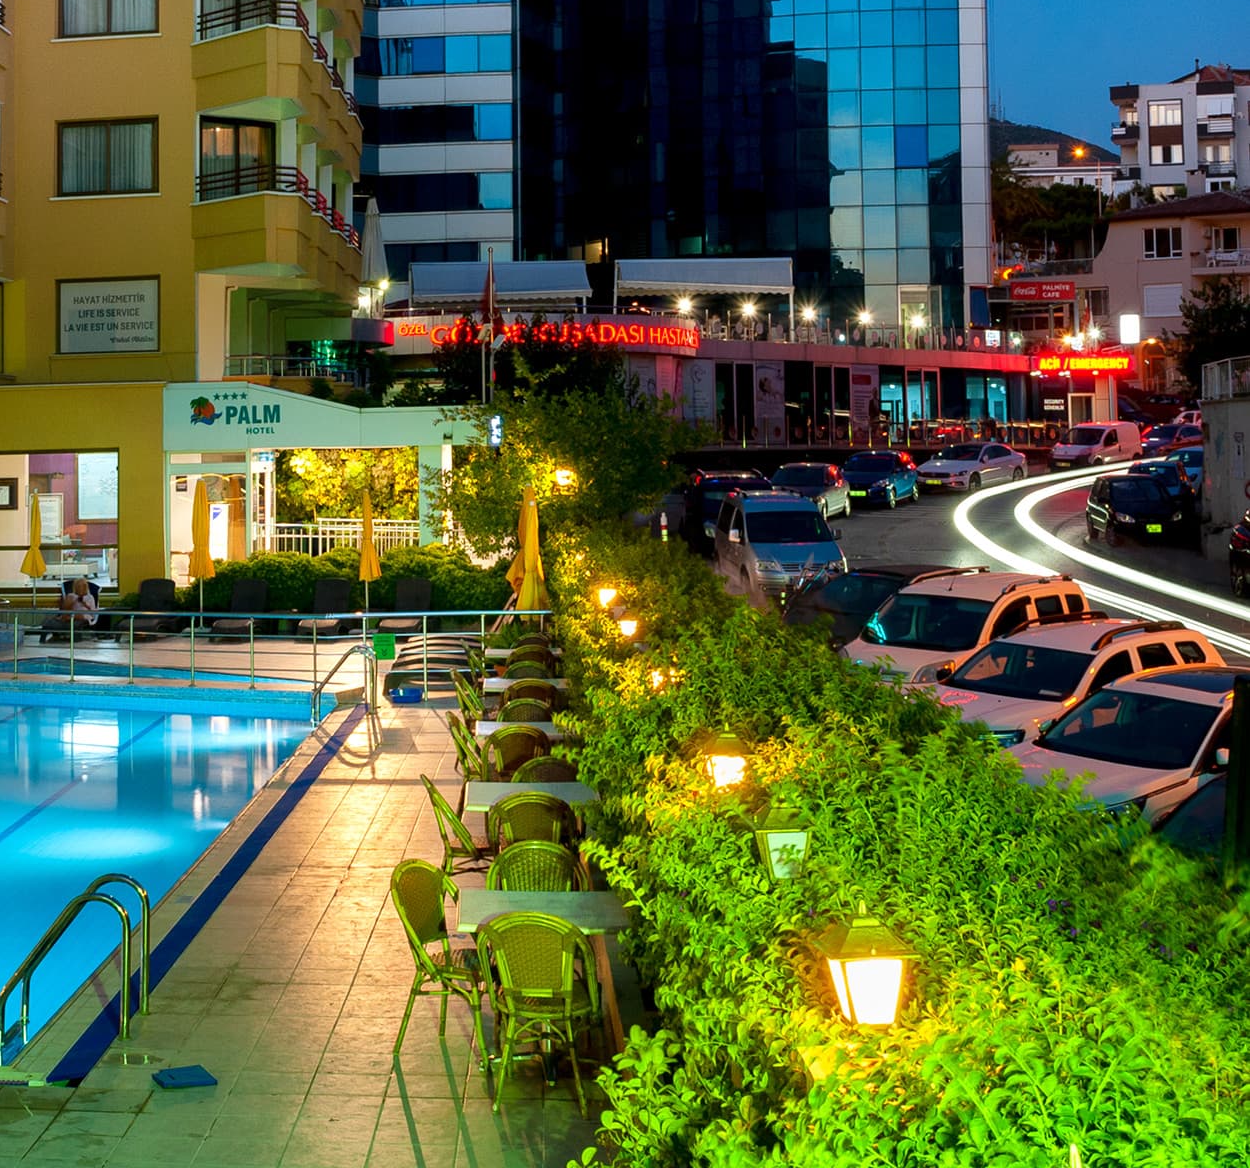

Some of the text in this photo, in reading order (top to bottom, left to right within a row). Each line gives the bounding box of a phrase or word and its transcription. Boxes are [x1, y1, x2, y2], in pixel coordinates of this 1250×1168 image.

[73, 293, 145, 305] HAYAT HİZMETTİR
[78, 307, 141, 318] LIFE IS SERVICE
[64, 320, 155, 333] LA VIE EST UN SERVICE
[399, 322, 427, 336] ÖZEL
[1069, 357, 1129, 369] EMERGENCY
[225, 404, 281, 425] PALM
[246, 427, 275, 435] HOTEL
